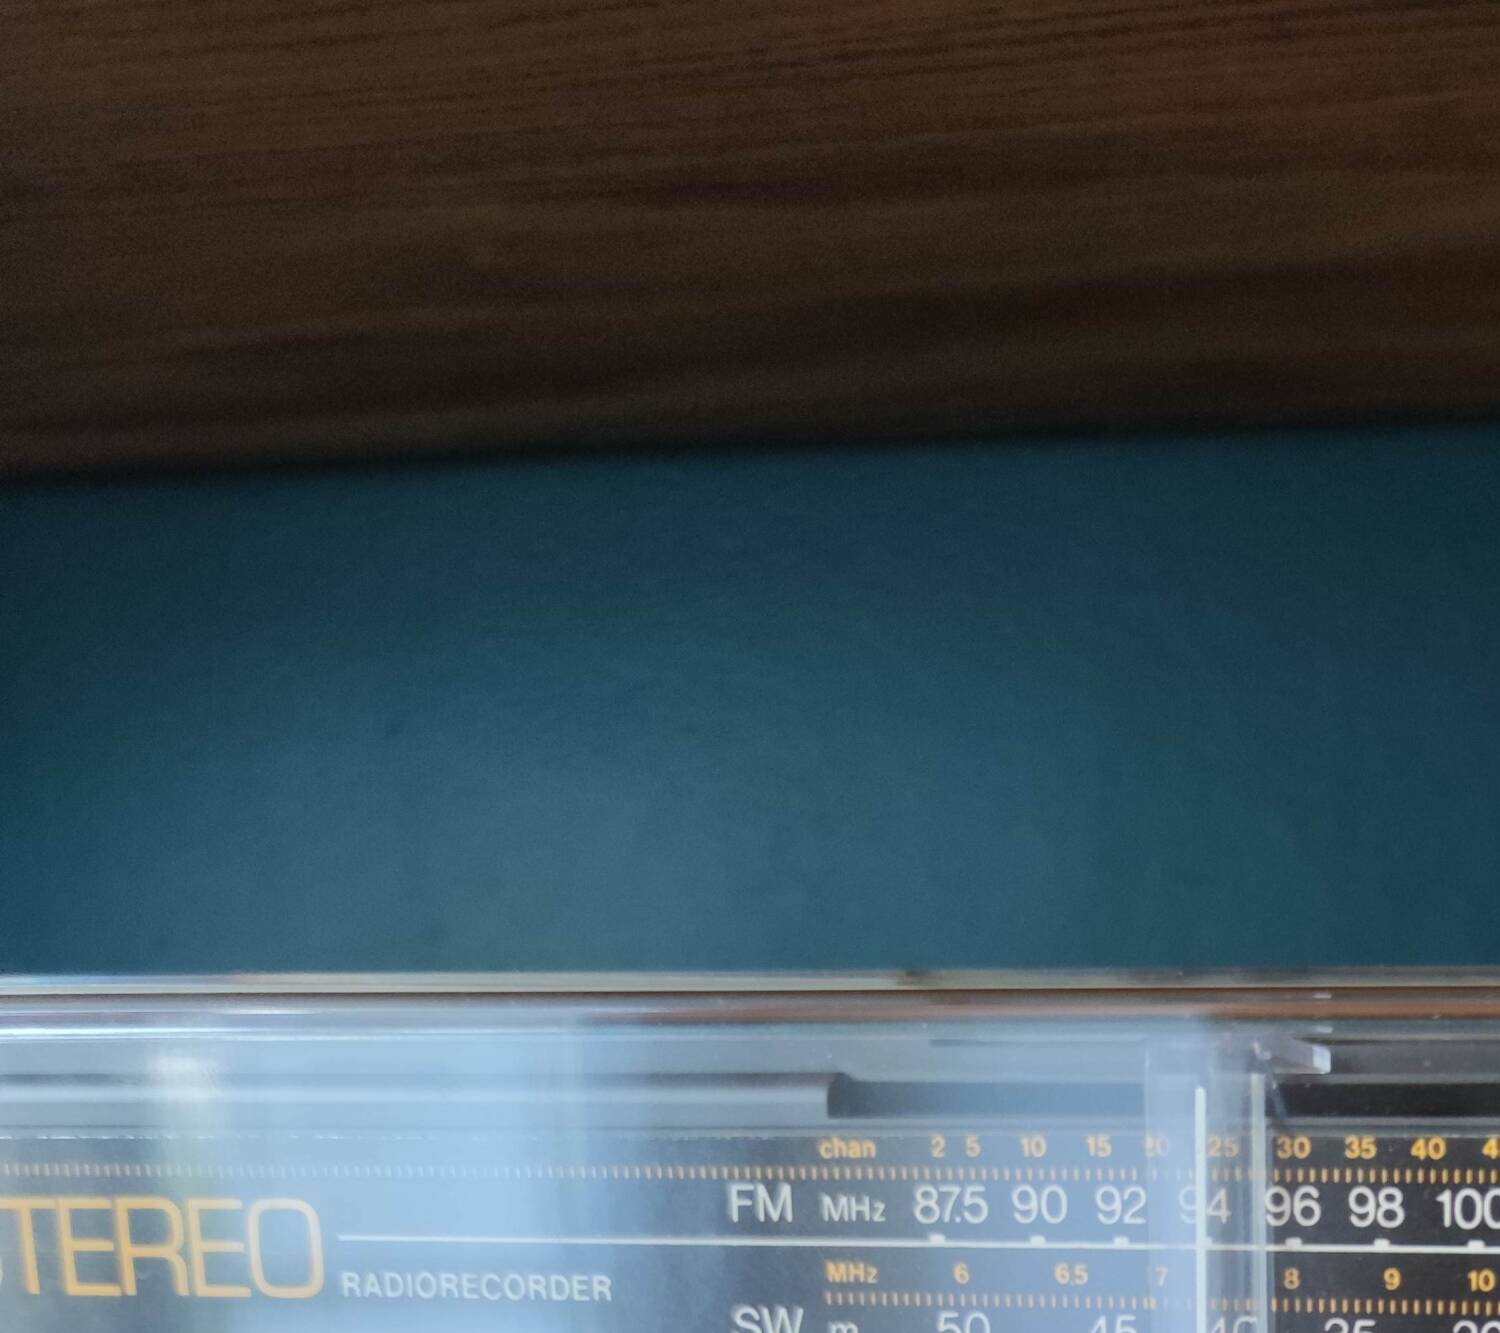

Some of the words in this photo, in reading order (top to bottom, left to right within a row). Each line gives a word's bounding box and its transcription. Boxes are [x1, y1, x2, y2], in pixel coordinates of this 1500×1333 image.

[818, 1137, 877, 1160] chan
[931, 1136, 946, 1158] 2
[965, 1136, 981, 1158] 5
[1022, 1136, 1047, 1158] 10
[1086, 1136, 1112, 1158] 15
[1206, 1135, 1239, 1158] 25
[1277, 1135, 1311, 1159] 30
[1344, 1136, 1377, 1160] 35
[1411, 1136, 1447, 1160] 40
[728, 1182, 794, 1224] FM
[821, 1194, 886, 1224] MHz
[913, 1185, 988, 1226] 87.5
[1013, 1185, 1068, 1226] 90
[1097, 1185, 1147, 1227] 92
[1178, 1186, 1233, 1226] 94
[1265, 1185, 1321, 1227] 96
[1348, 1186, 1405, 1229] 98
[0, 1194, 325, 1299] TEREO
[340, 1270, 612, 1302] RADIORECORDER
[825, 1261, 878, 1284] MHz
[954, 1264, 969, 1285] 6
[1055, 1264, 1089, 1286] 6.5
[1156, 1267, 1169, 1287] 7
[1284, 1267, 1300, 1290] 8
[1383, 1267, 1401, 1291] 9
[1467, 1269, 1496, 1292] 10
